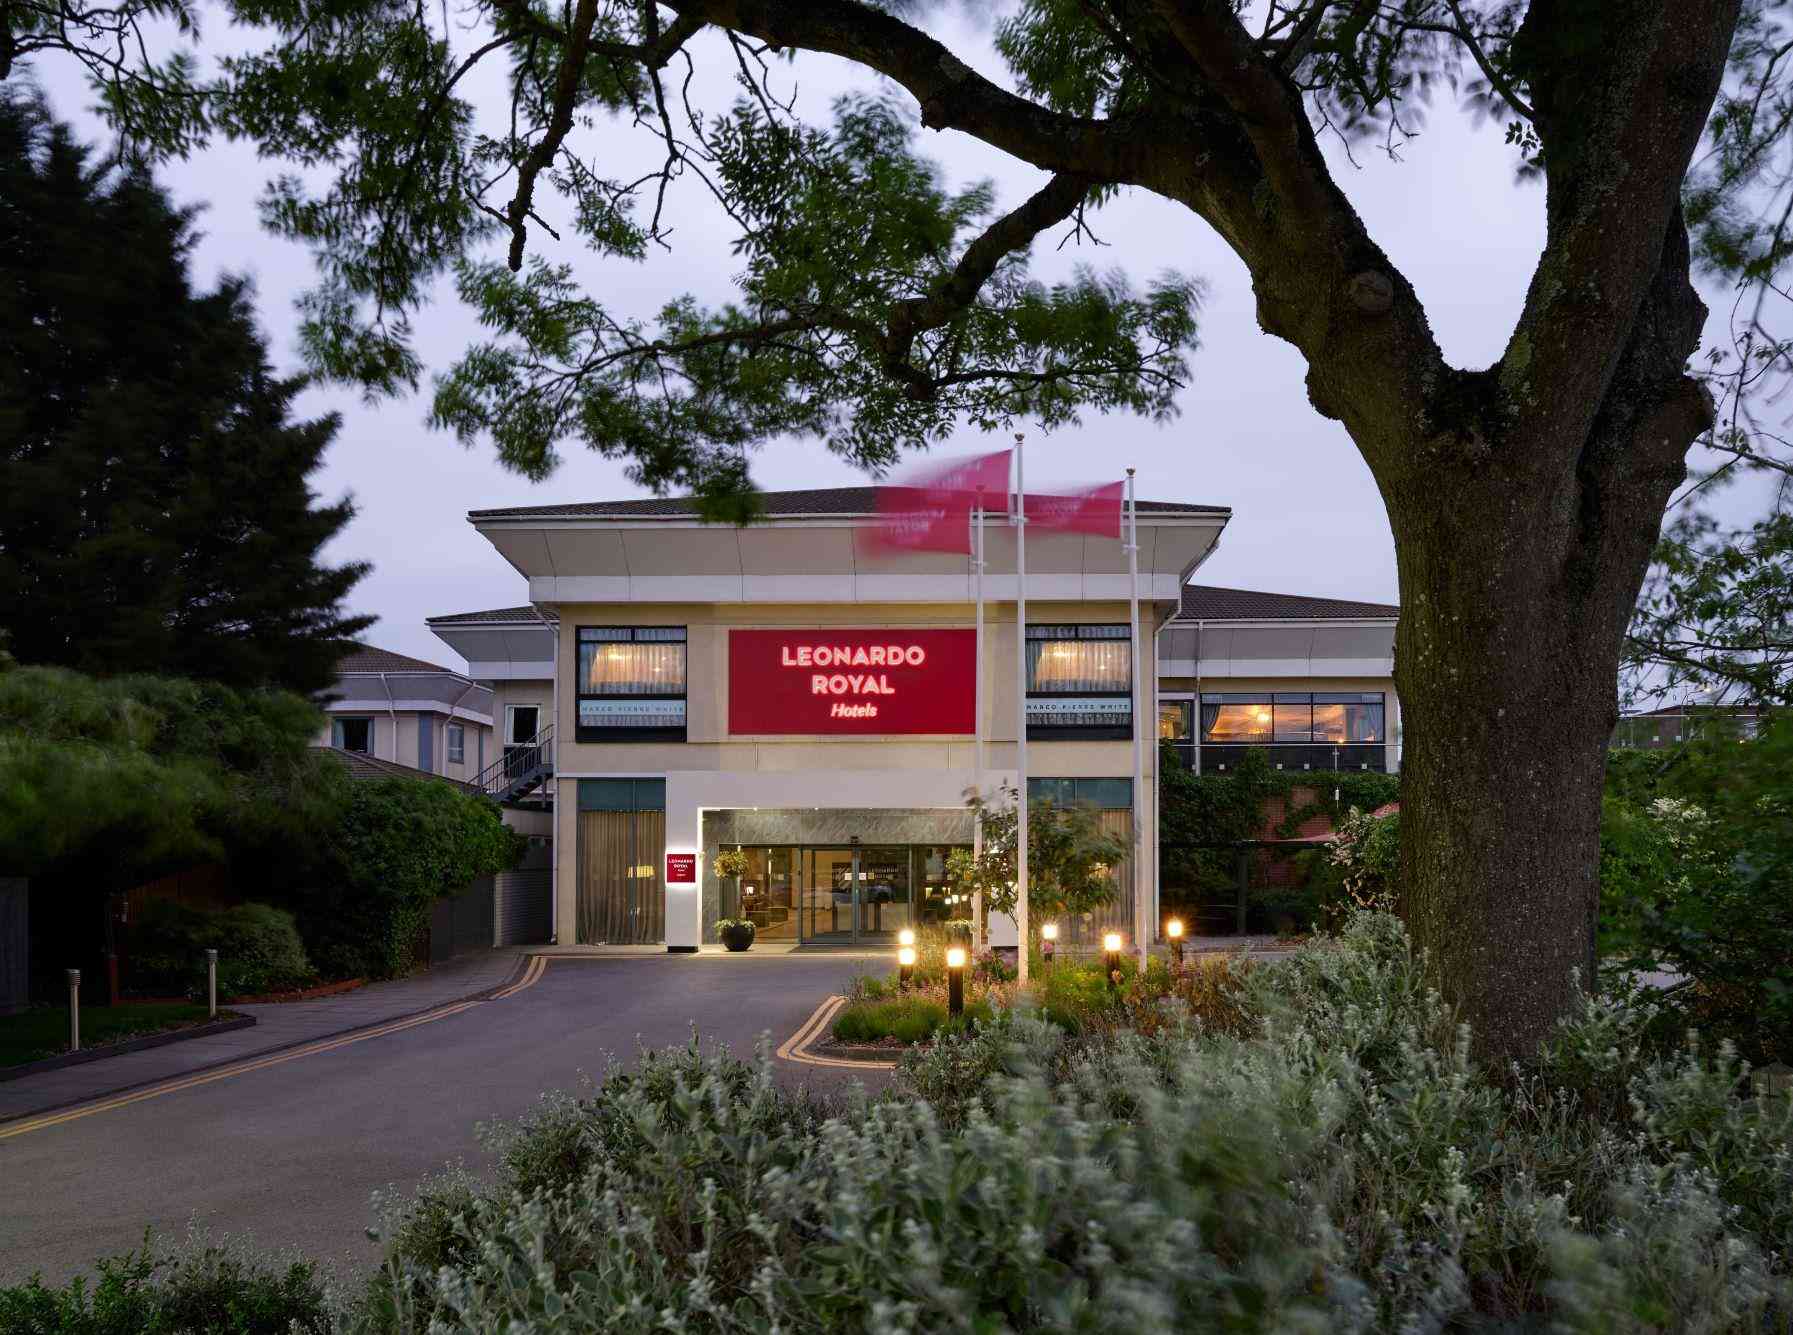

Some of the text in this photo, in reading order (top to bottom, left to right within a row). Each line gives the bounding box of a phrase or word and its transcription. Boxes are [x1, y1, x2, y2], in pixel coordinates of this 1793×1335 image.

[782, 646, 925, 666] LEONARDO
[812, 674, 895, 694] ROYAL
[830, 702, 878, 717] Hotels
